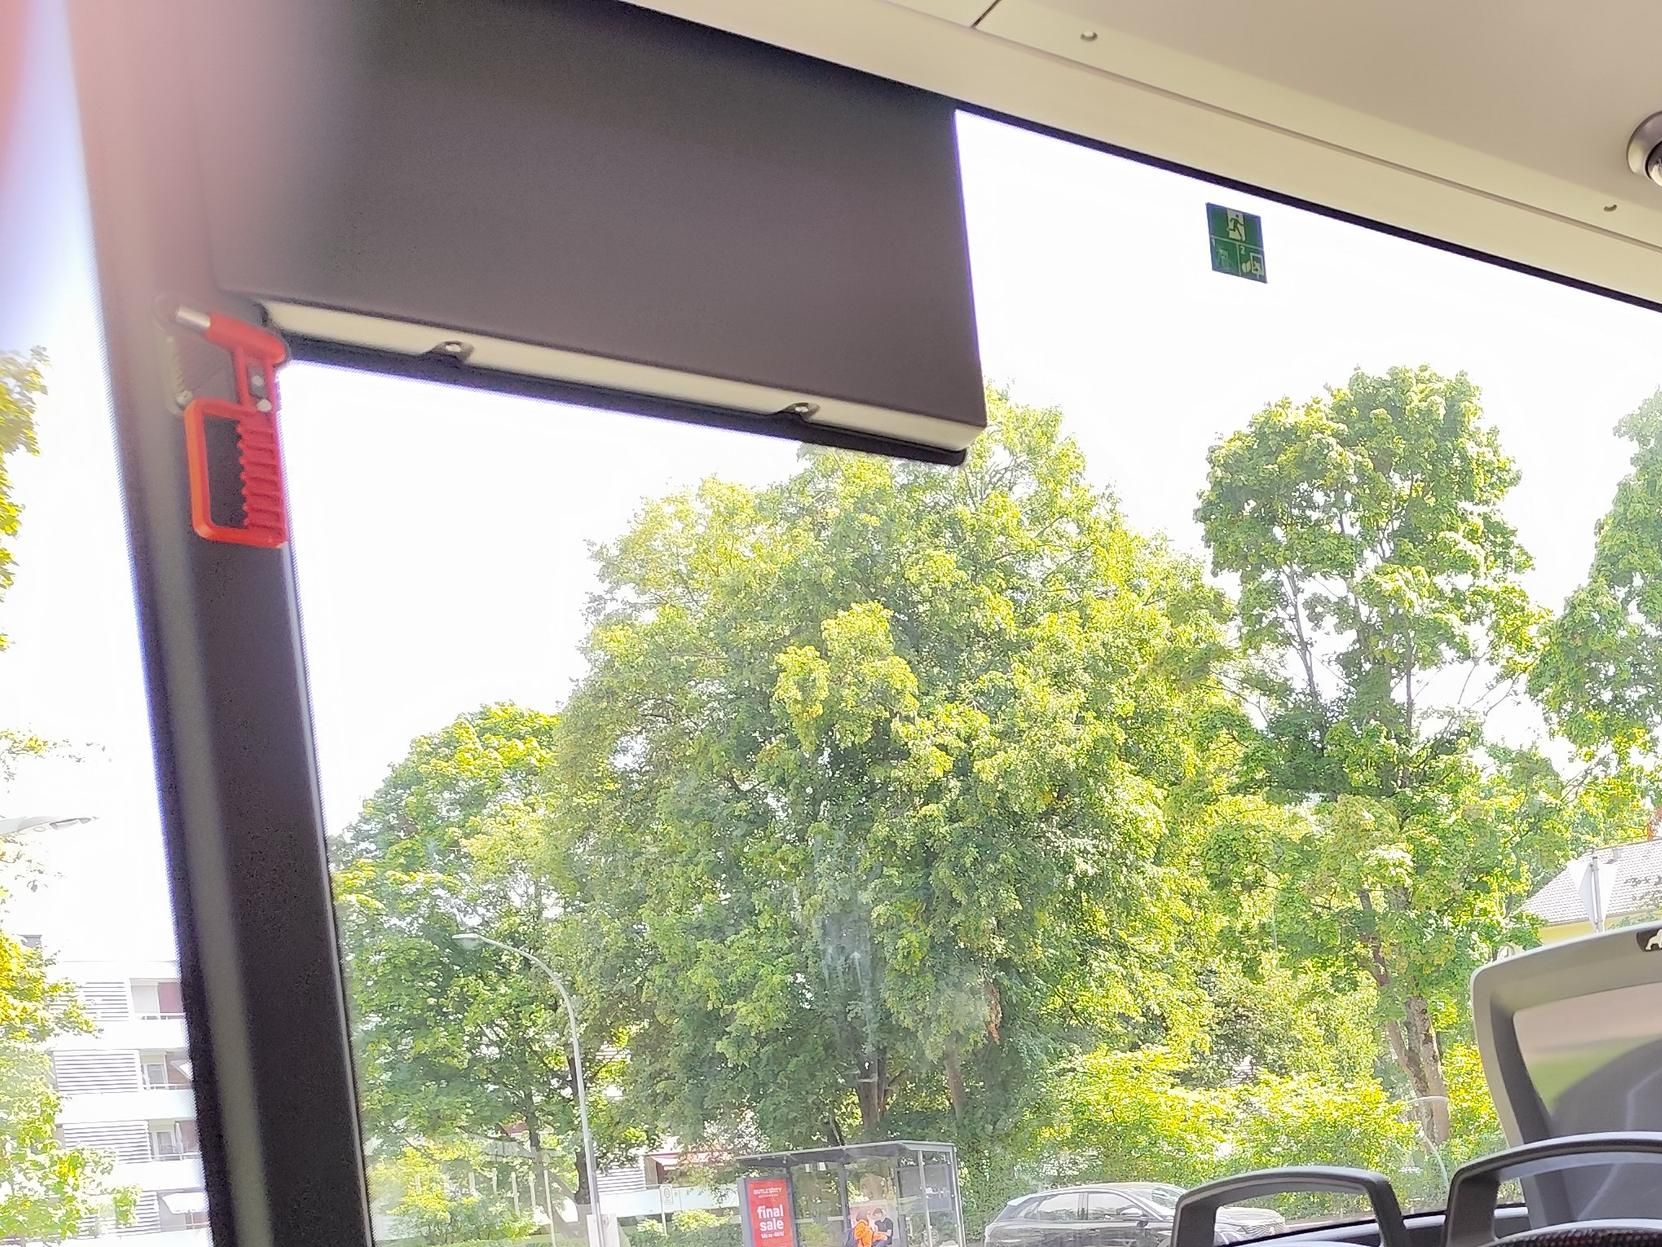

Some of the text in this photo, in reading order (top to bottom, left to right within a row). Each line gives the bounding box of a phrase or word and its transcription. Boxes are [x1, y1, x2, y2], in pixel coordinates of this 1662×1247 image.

[1239, 245, 1246, 254] 2
[757, 1203, 784, 1219] final
[760, 1218, 784, 1231] sale
